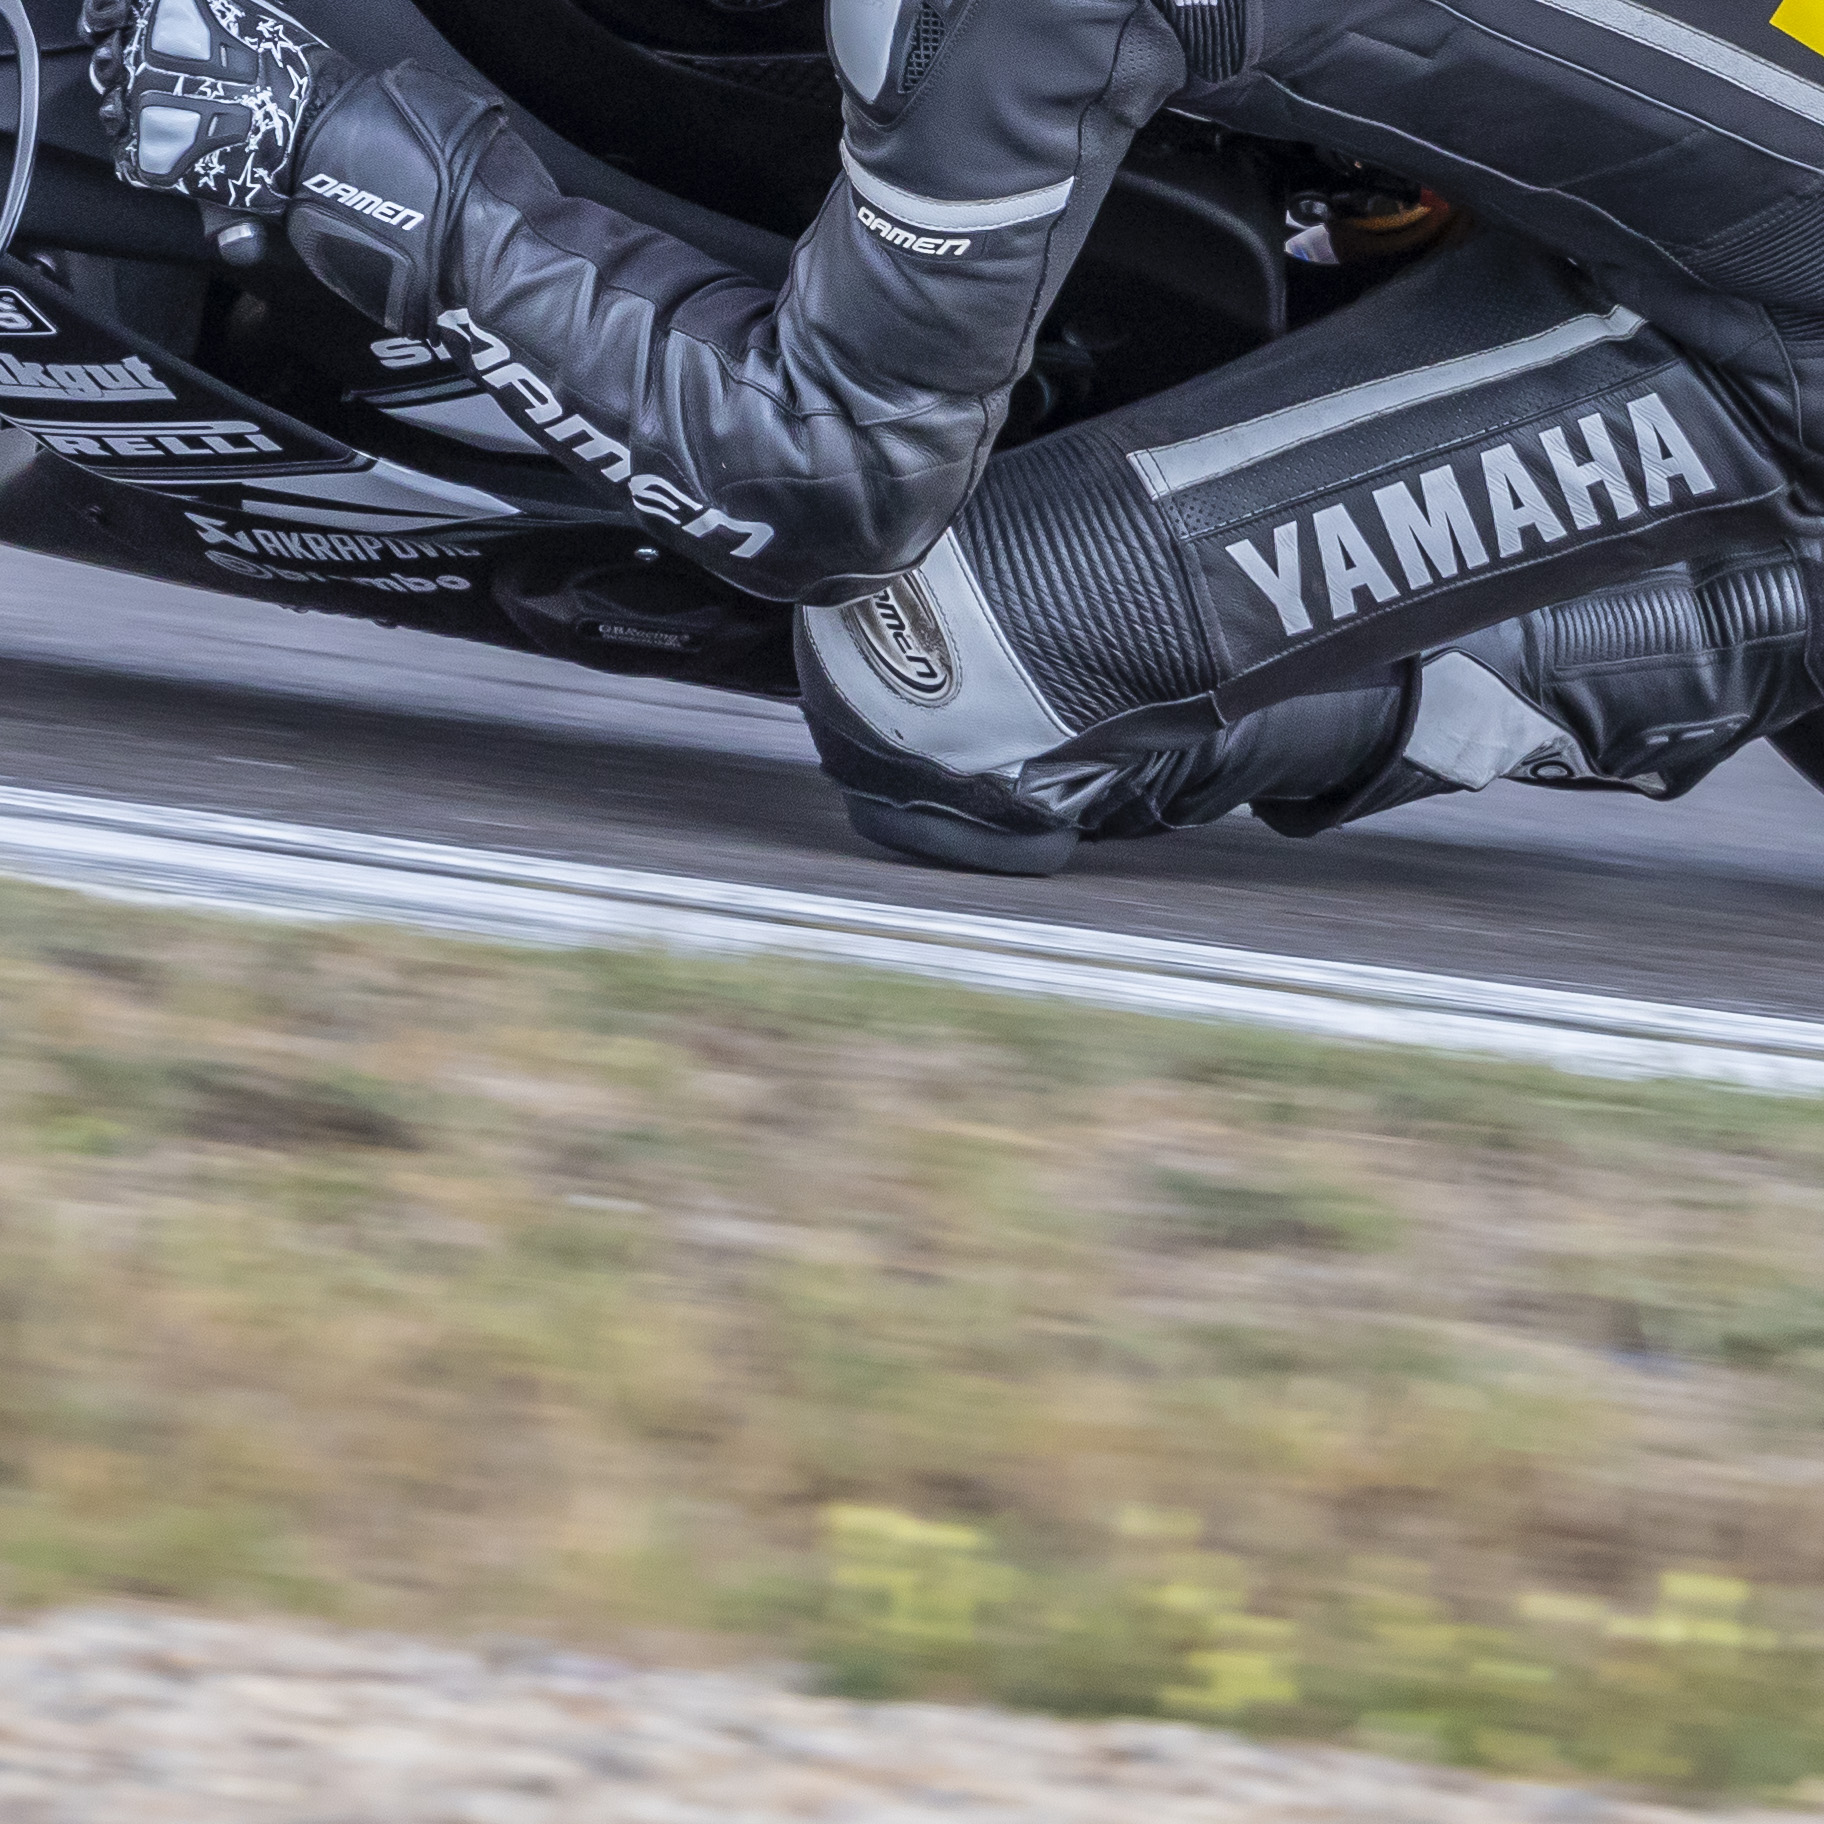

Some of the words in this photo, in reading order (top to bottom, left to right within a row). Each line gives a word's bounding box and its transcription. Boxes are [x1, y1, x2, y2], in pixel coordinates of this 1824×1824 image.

[303, 173, 425, 231] DAMEN
[857, 204, 972, 256] DAMEN
[437, 308, 774, 559] DAMEN
[1225, 391, 1716, 638] YAMAHA
